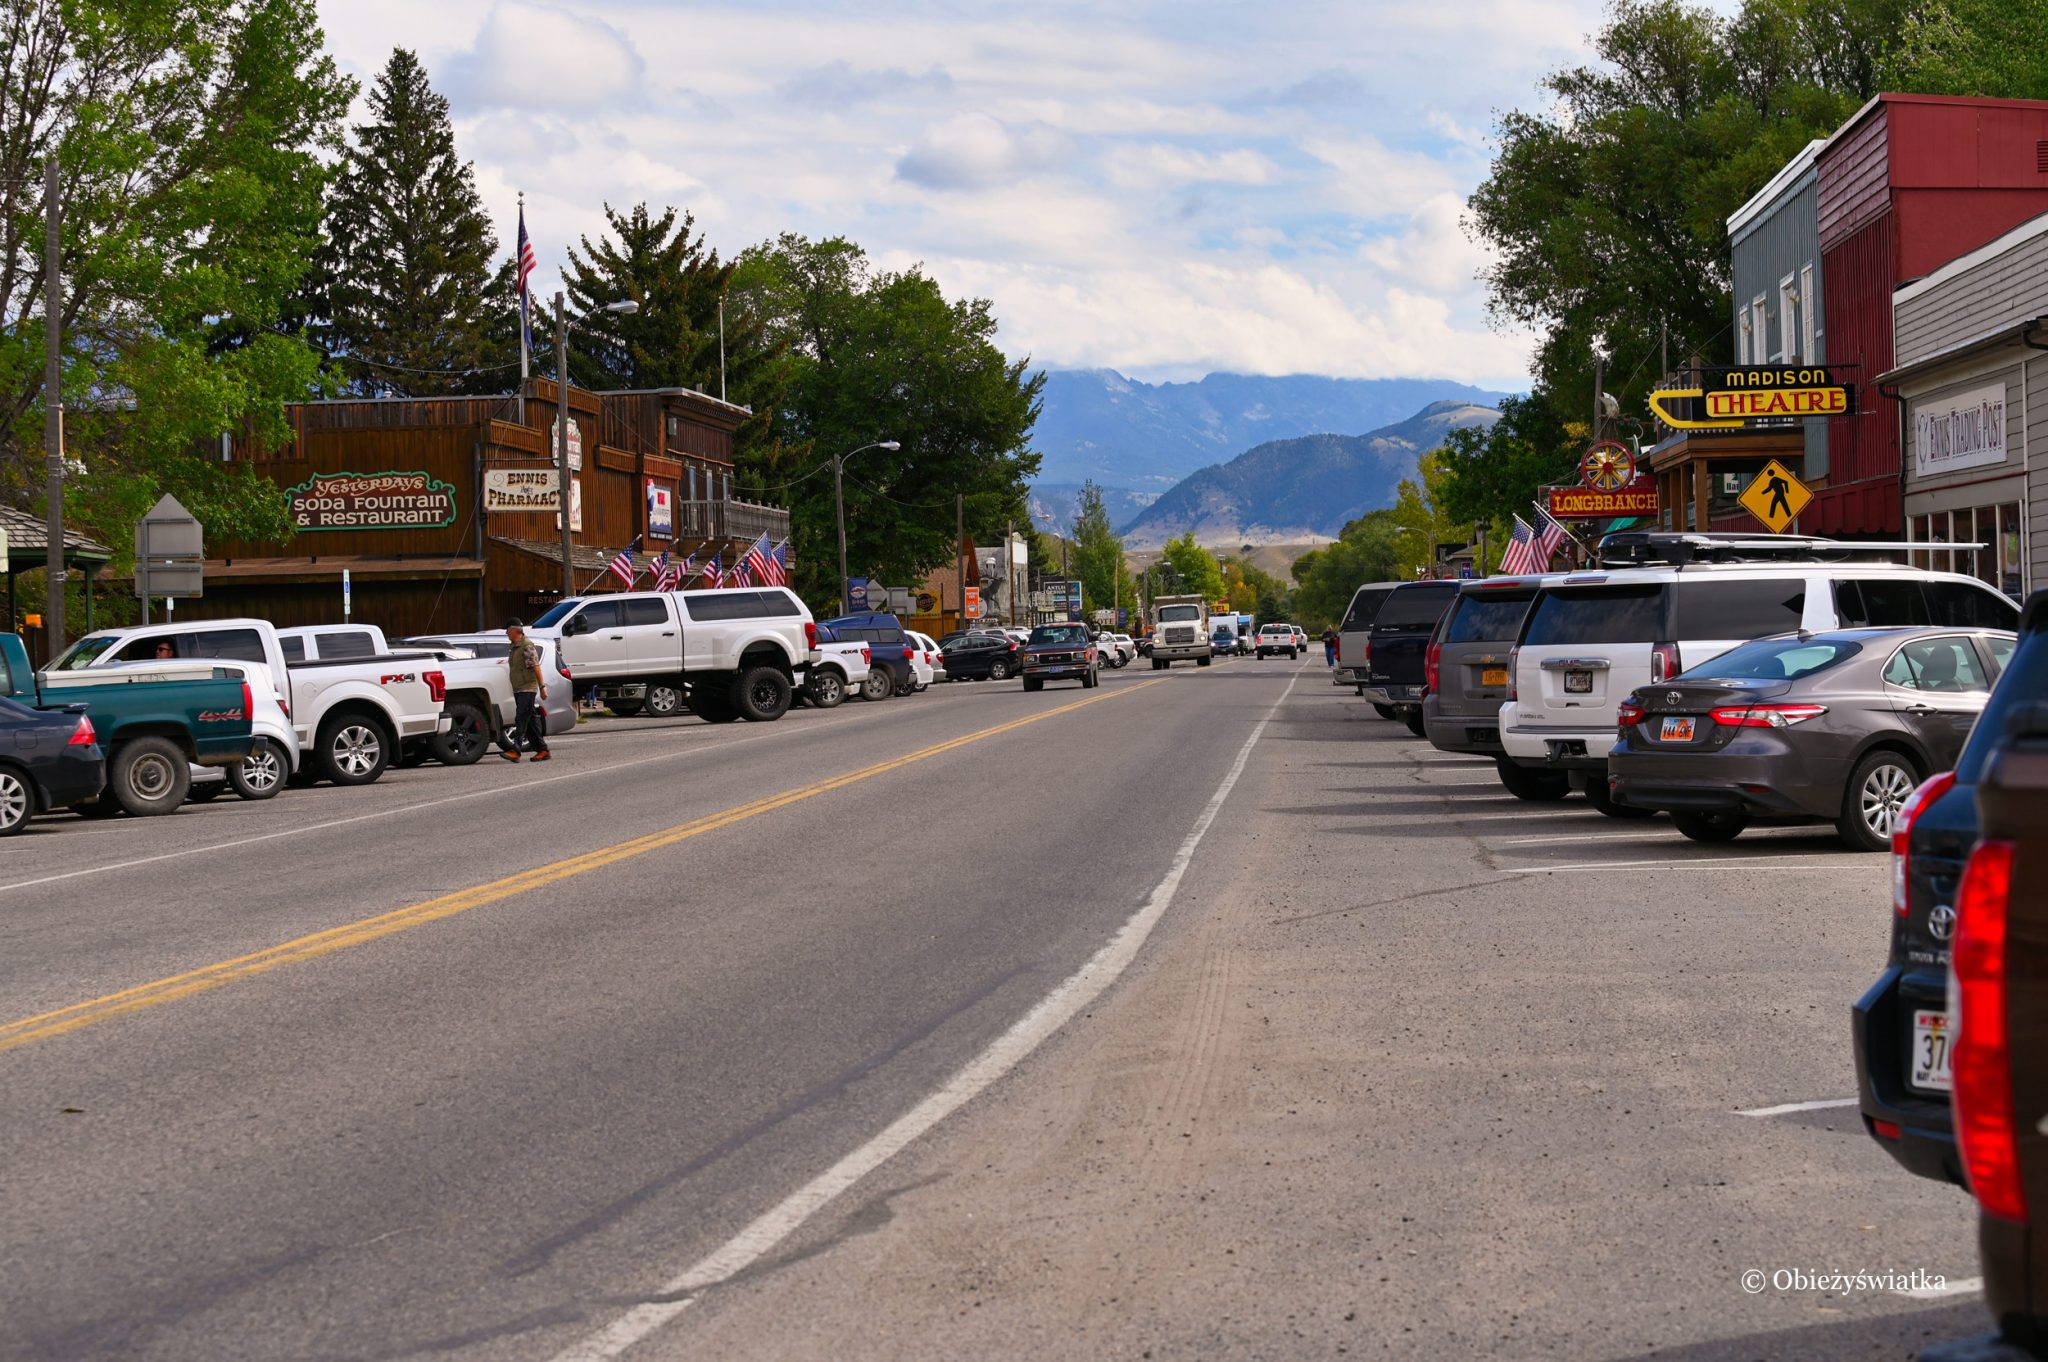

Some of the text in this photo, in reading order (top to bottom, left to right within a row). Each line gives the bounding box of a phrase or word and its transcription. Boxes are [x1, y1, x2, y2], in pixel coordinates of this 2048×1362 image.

[1726, 369, 1825, 387] MADISON
[1708, 390, 1846, 415] THEATRE
[1951, 408, 1981, 456] TRADING
[1983, 400, 2003, 451] POST
[507, 473, 547, 485] ENNIS
[294, 494, 448, 511] SODA FOUNTAIN
[1554, 493, 1658, 512] LONGBRANCH
[296, 510, 443, 525] & RESTAURANT
[380, 673, 416, 685] FX4
